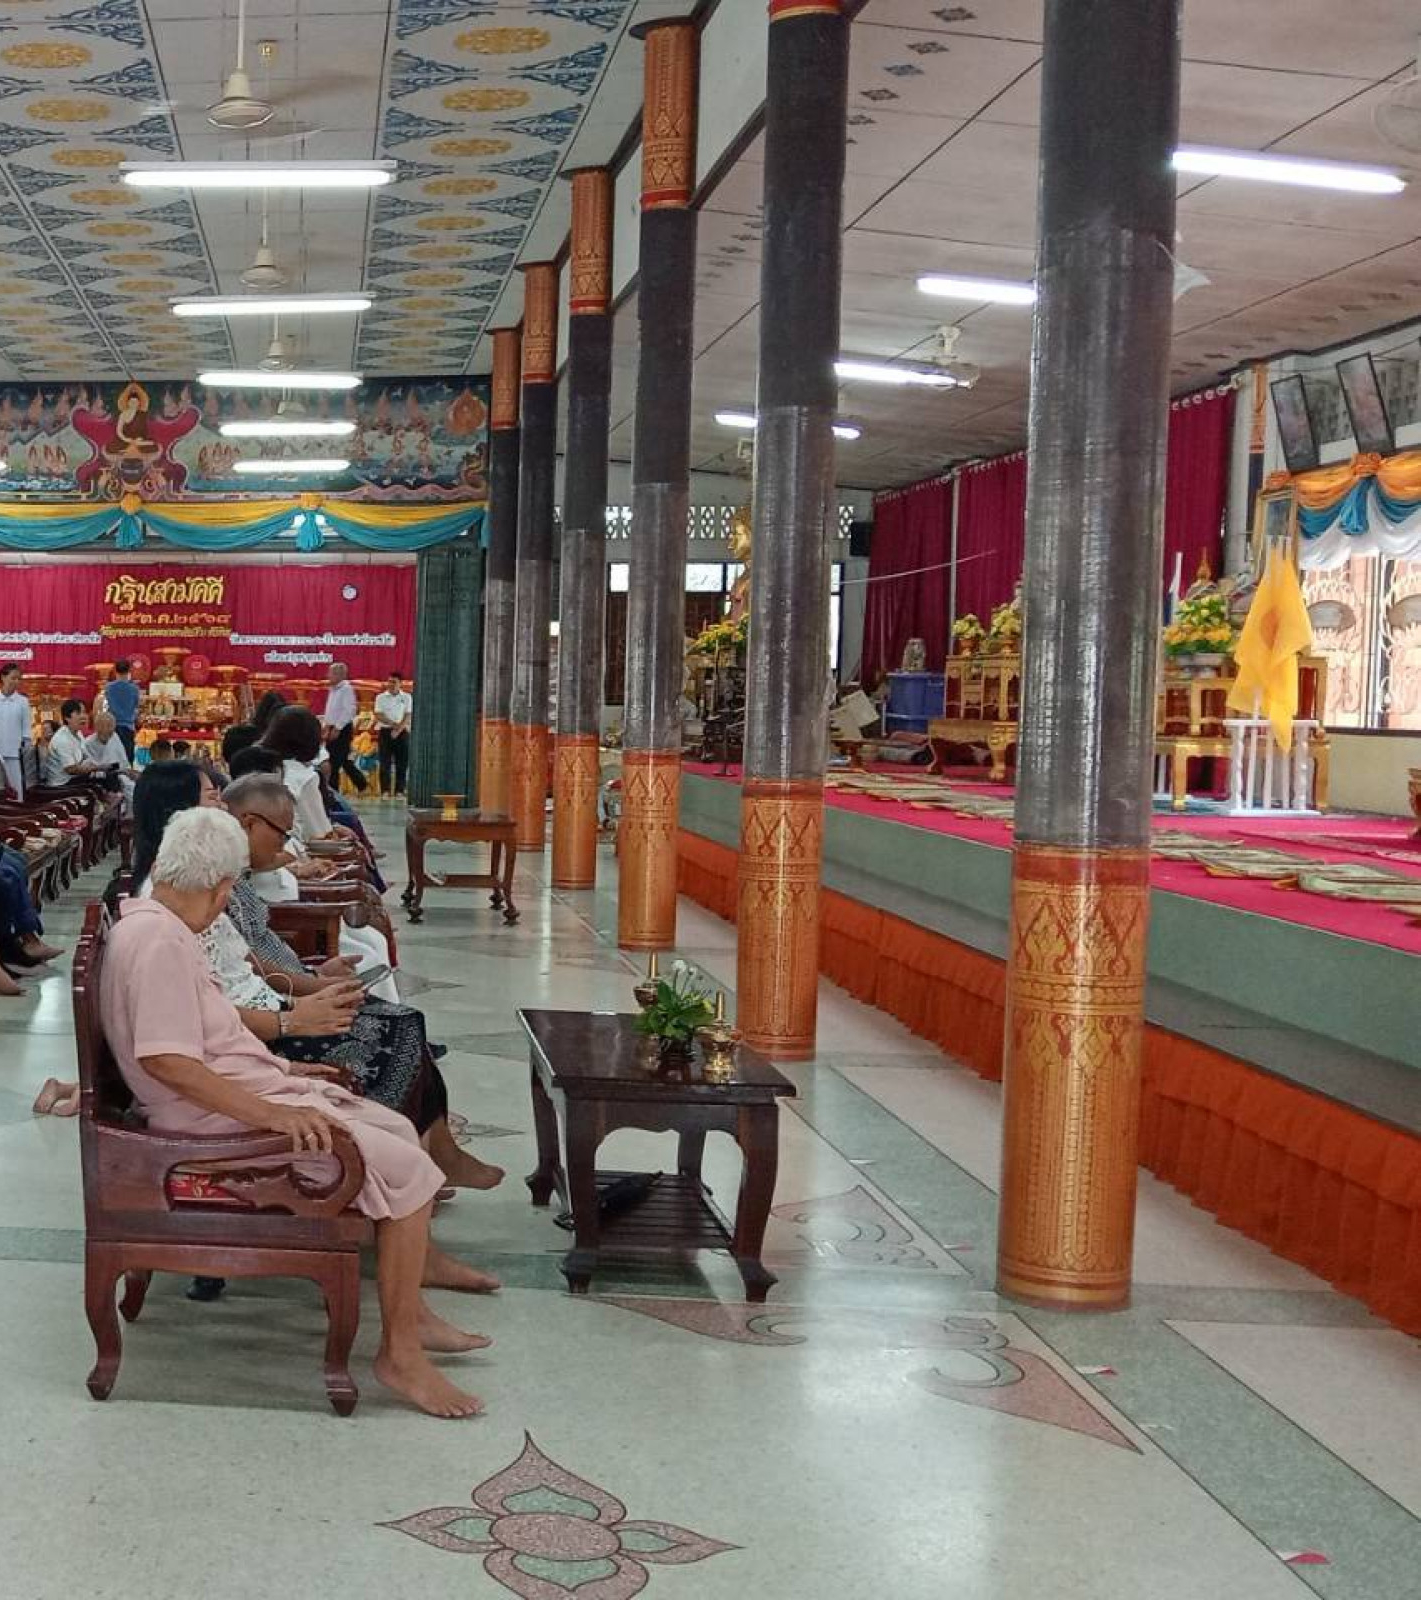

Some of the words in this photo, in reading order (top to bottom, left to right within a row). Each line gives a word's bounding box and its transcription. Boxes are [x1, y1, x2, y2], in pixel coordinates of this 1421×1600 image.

[104, 574, 224, 610] กฐินสามัคคี
